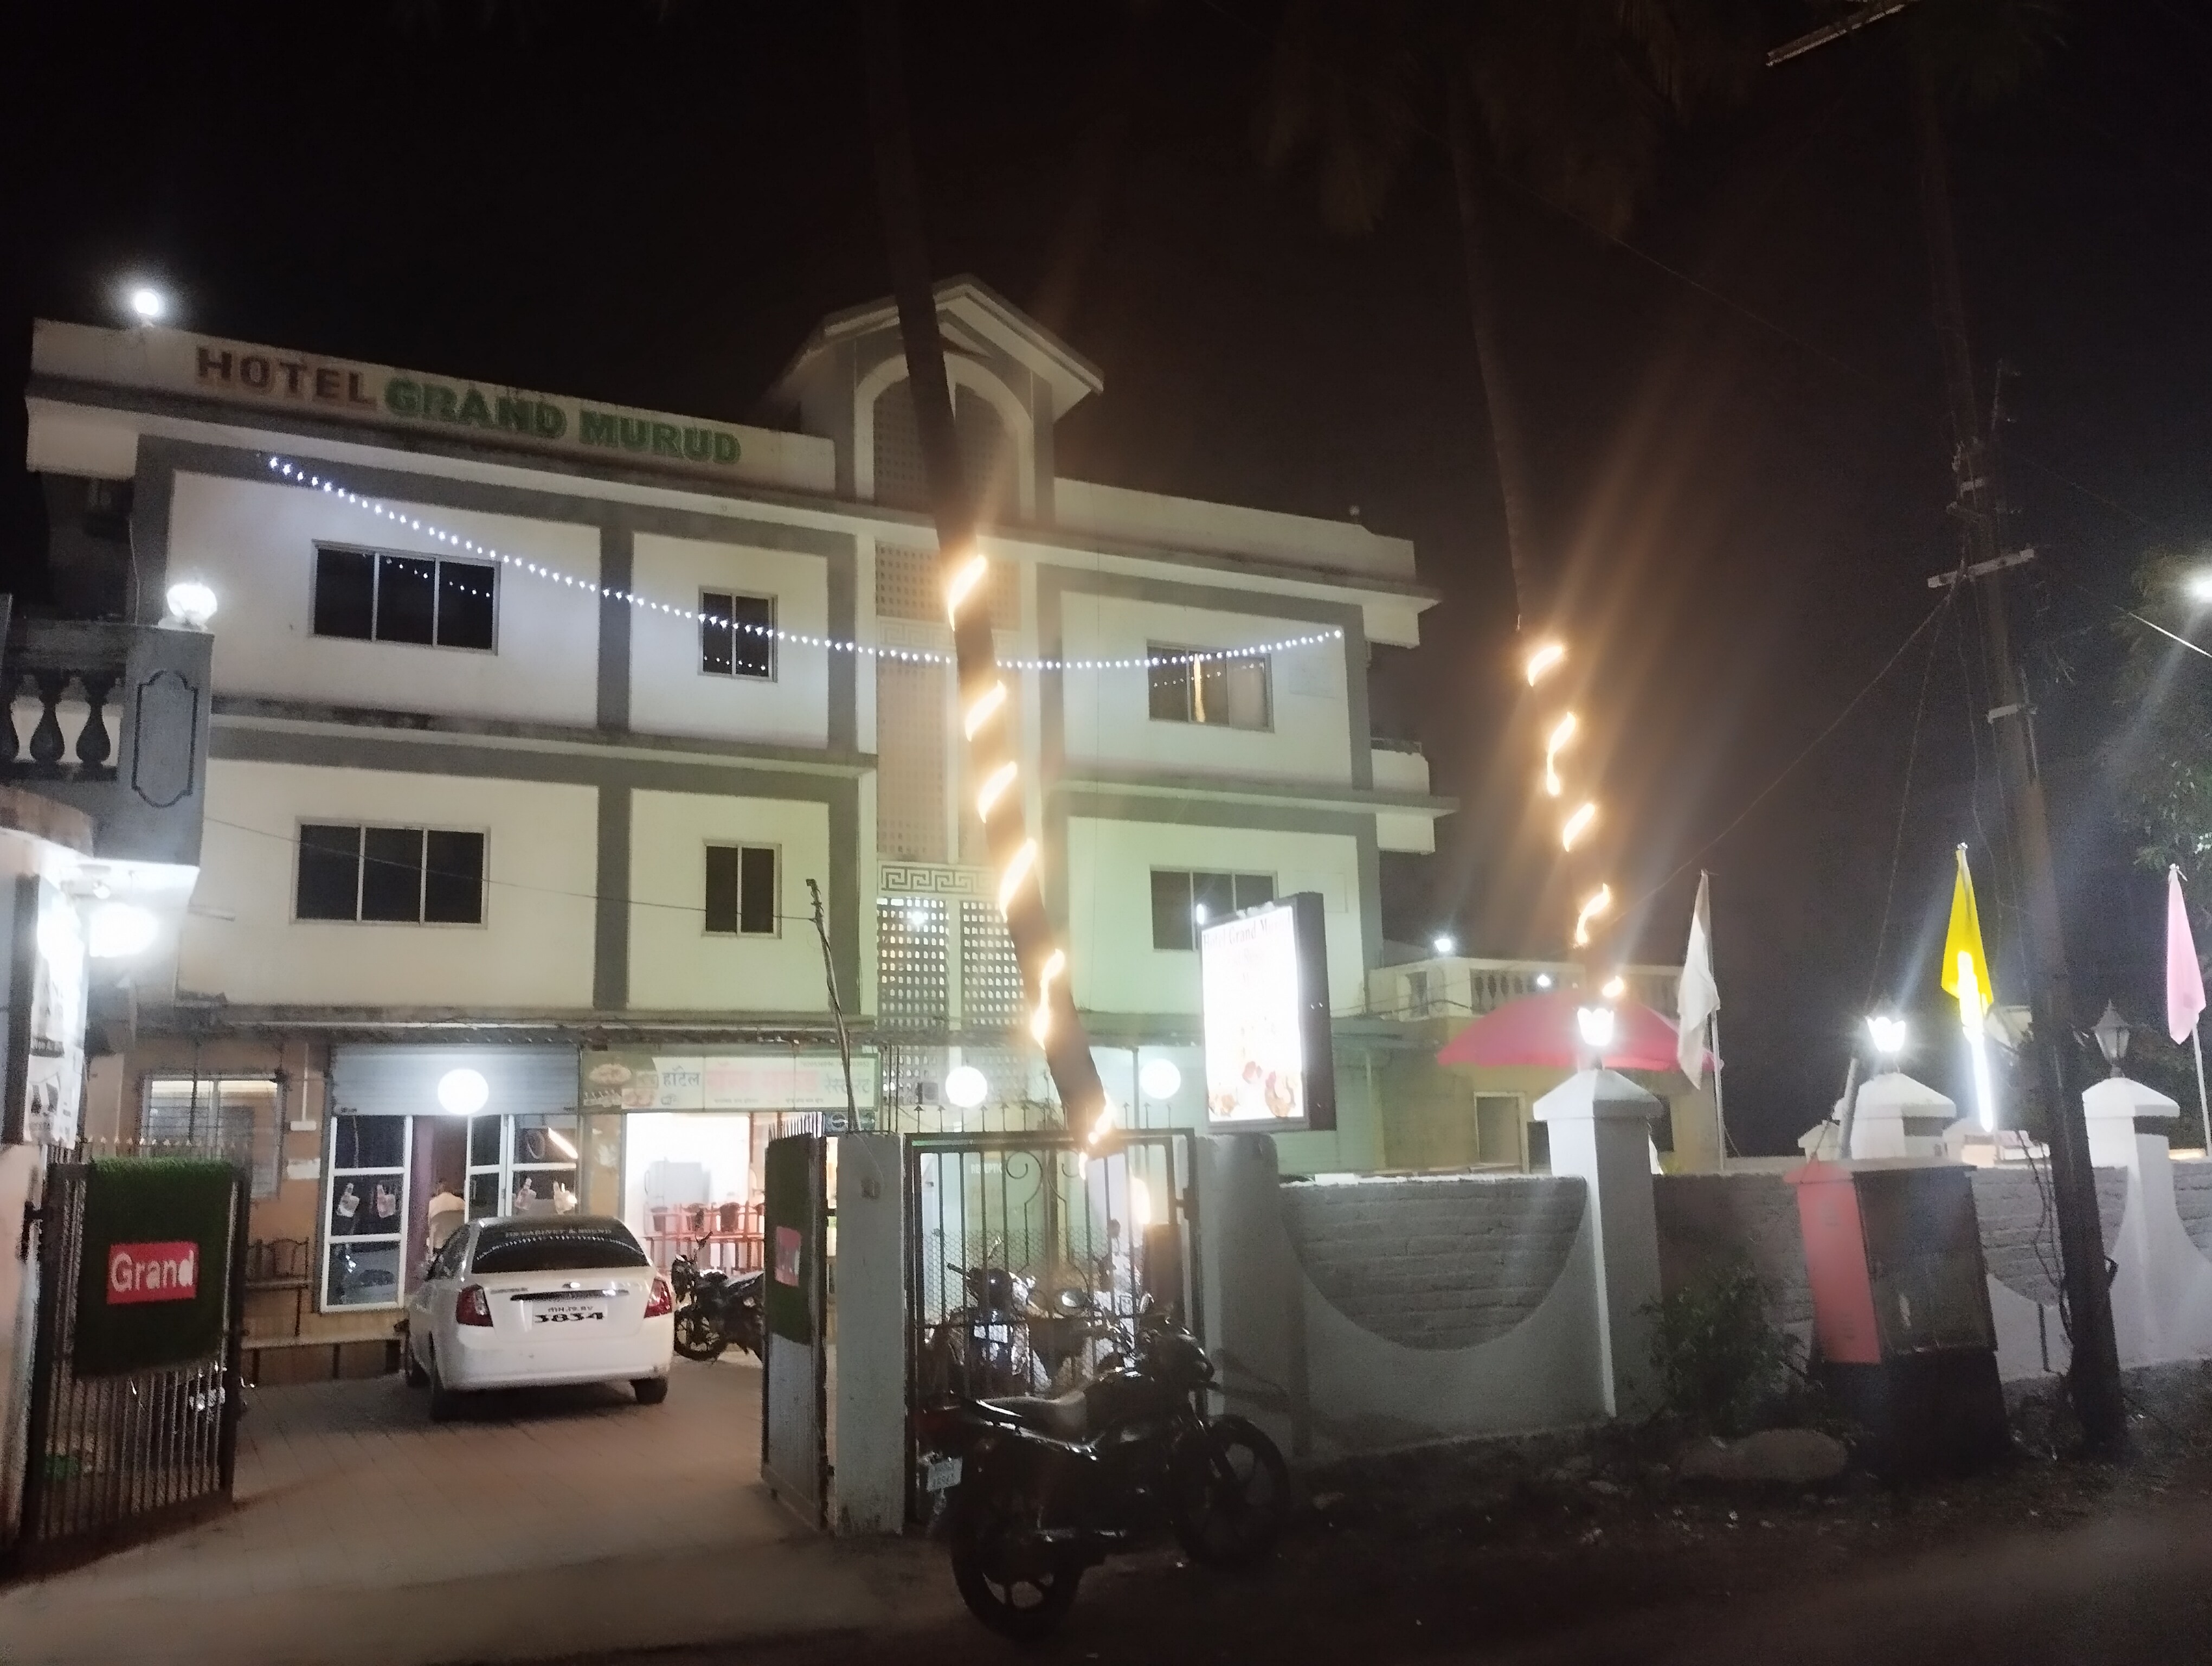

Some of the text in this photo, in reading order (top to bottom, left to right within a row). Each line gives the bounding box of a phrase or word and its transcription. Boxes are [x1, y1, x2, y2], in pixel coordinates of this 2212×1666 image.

[196, 346, 741, 464] HOTEL GRAND MURUD
[1229, 920, 1256, 945] Grand
[663, 1065, 700, 1087] हॉटेल
[112, 1250, 195, 1292] Grand
